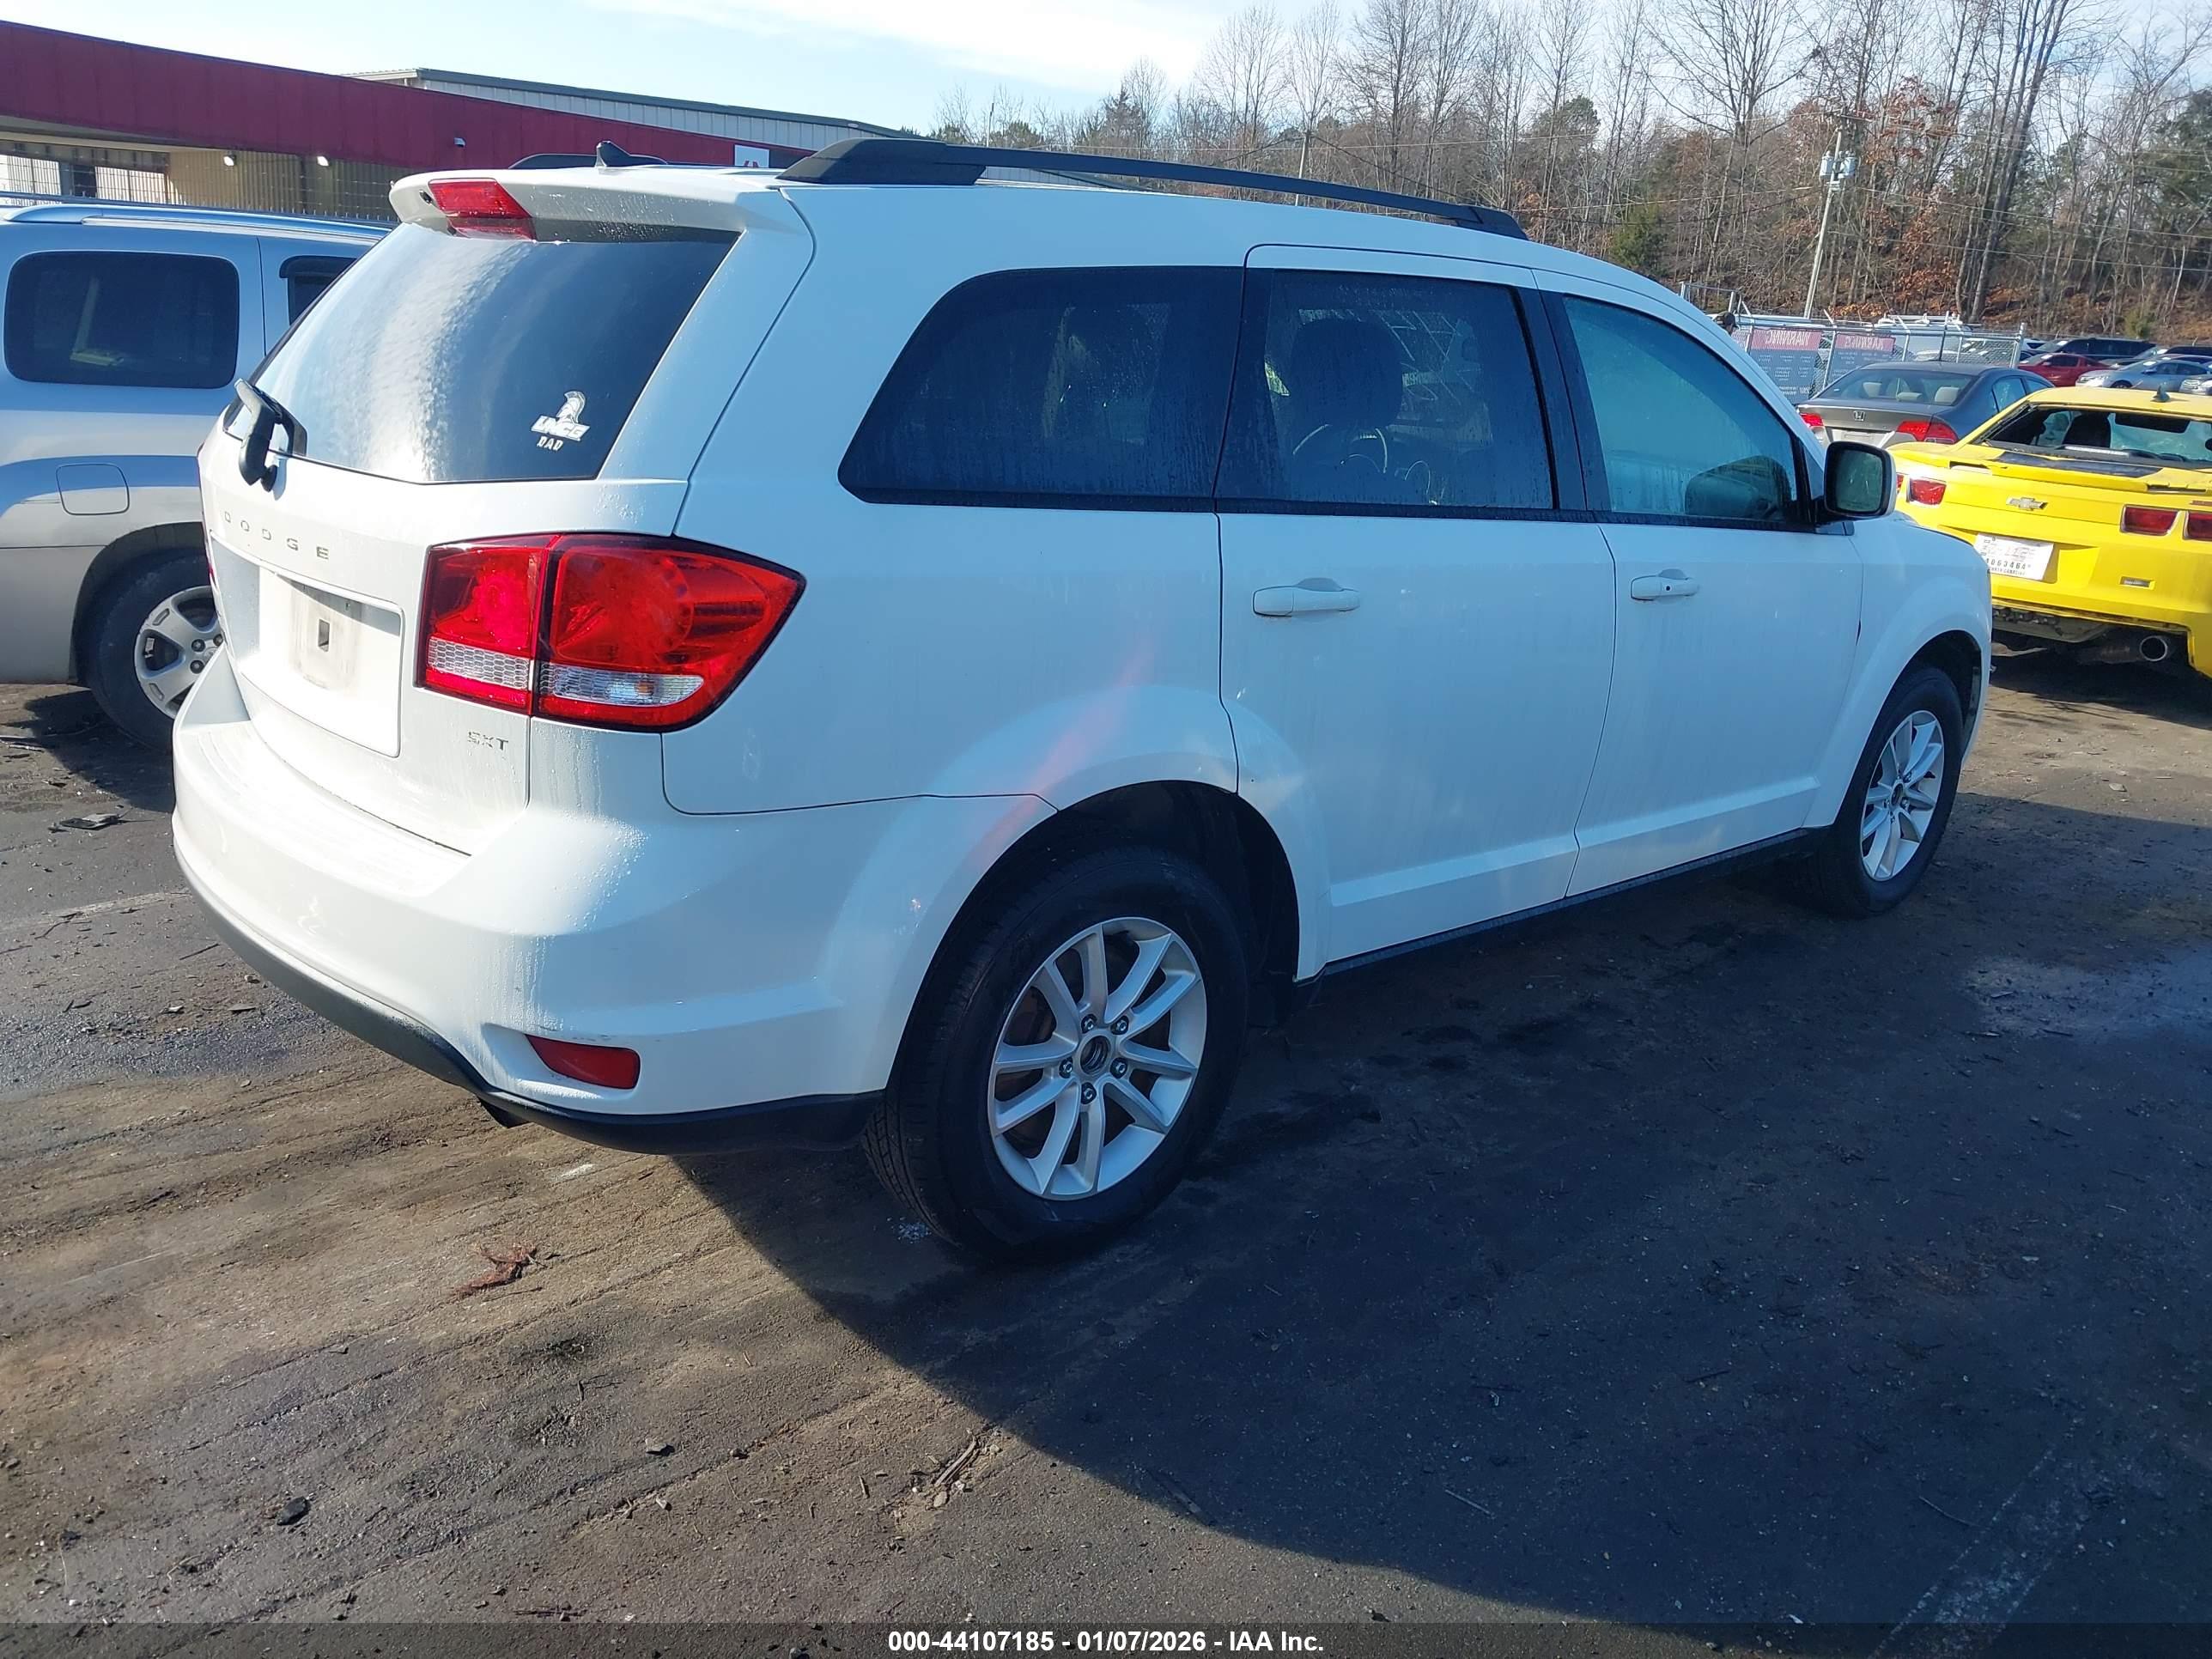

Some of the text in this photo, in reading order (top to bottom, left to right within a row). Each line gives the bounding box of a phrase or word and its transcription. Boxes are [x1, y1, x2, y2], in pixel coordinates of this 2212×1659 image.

[536, 435, 563, 451] DAD
[224, 511, 329, 560] DODGE
[467, 731, 509, 750] SXT
